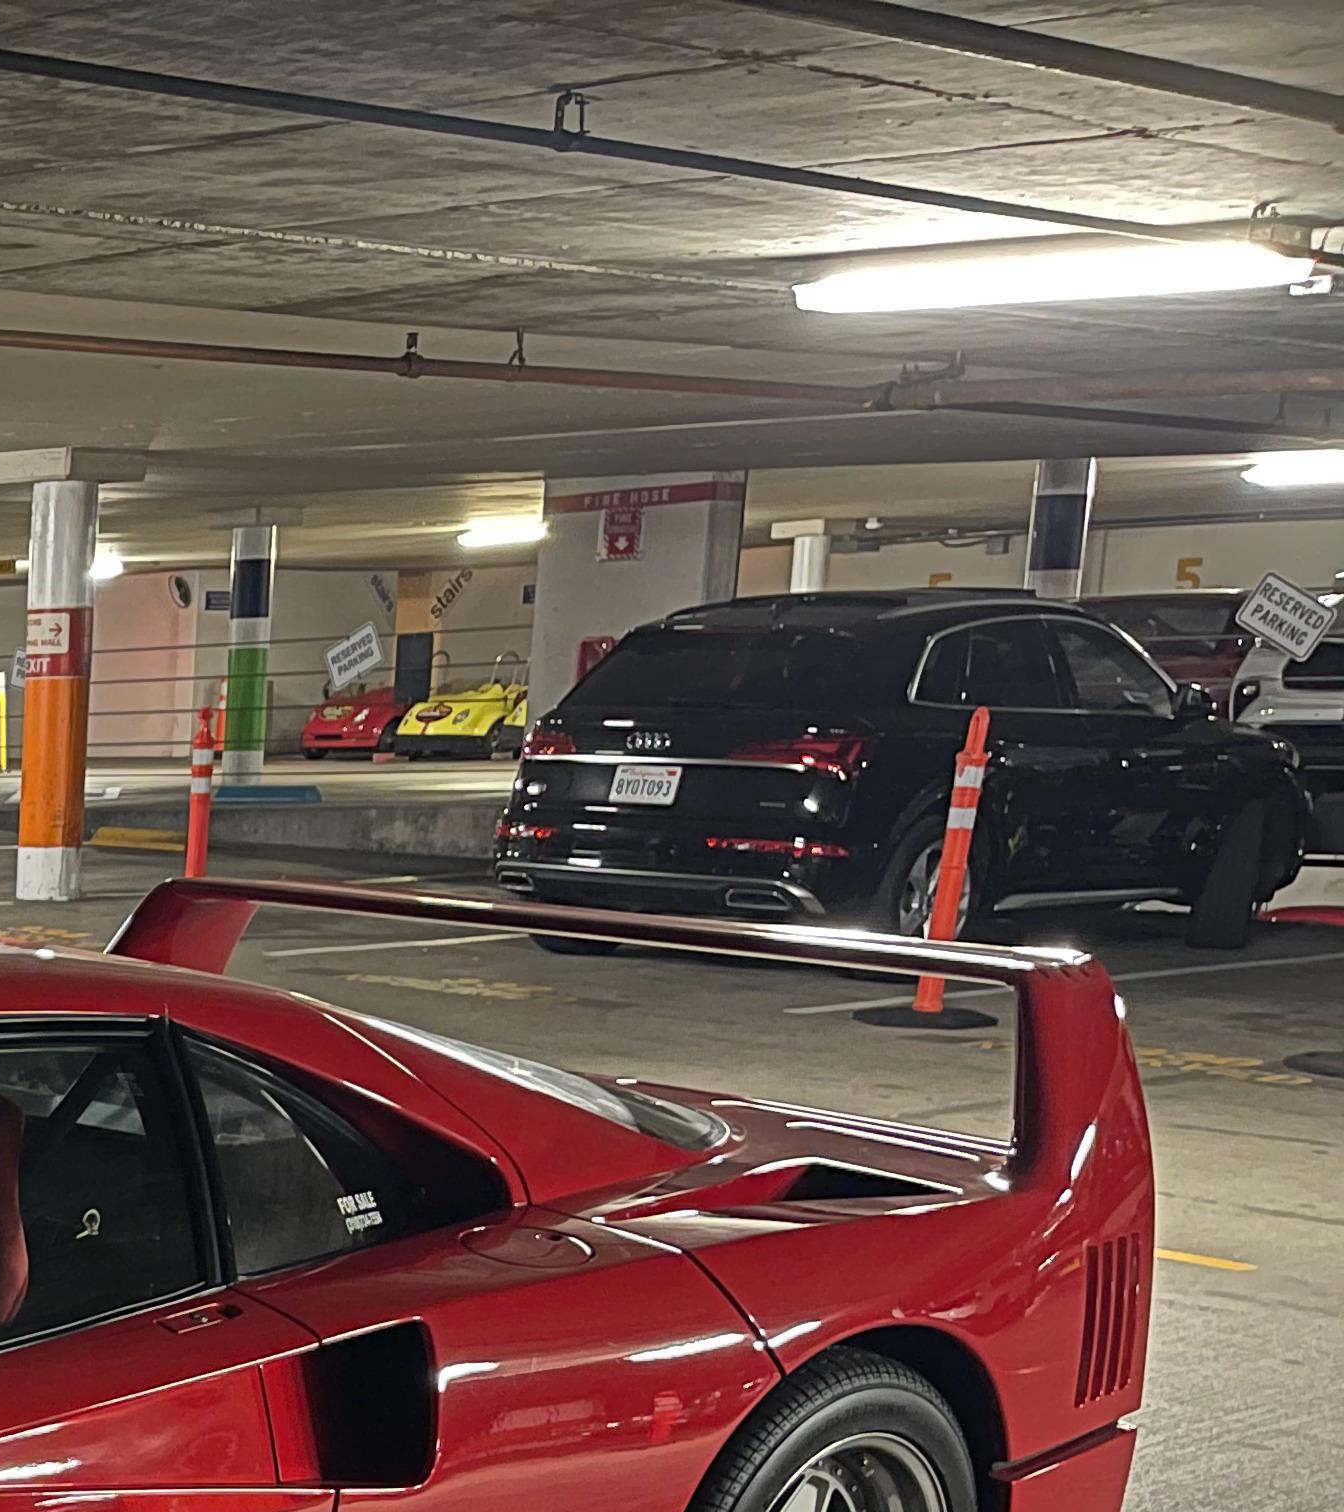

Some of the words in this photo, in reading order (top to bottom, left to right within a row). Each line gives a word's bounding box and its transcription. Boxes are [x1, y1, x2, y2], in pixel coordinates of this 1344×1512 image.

[631, 488, 670, 504] HOSE
[430, 568, 473, 619] stairs
[1259, 582, 1325, 630] RESERVED
[1251, 604, 1308, 646] PARKING
[330, 632, 374, 666] RESERVED
[337, 647, 374, 676] PARKING
[337, 1195, 358, 1215] FOR
[355, 1191, 377, 1210] SALE
